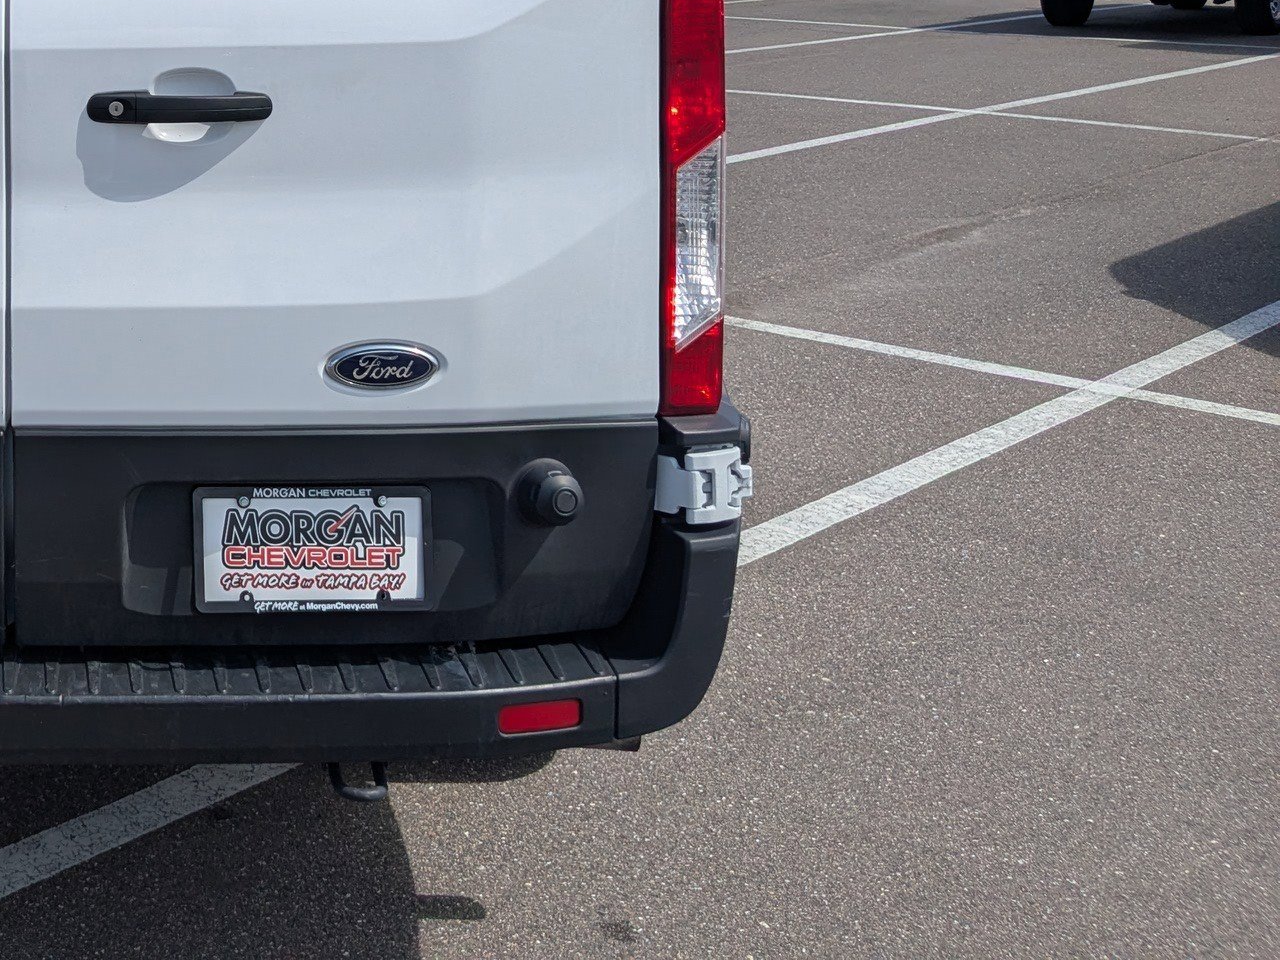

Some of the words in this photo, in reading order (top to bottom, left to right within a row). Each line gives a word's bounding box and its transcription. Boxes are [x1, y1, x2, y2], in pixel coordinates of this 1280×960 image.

[352, 354, 414, 380] Ford
[253, 488, 306, 498] MORGAN
[308, 489, 371, 497] CHEVROLET
[223, 505, 404, 546] MORGAN
[223, 545, 404, 569] CHEVROLET
[221, 573, 253, 590] GET
[253, 573, 300, 589] MORE
[315, 573, 368, 590] TAMPA
[369, 573, 406, 591] BAY!
[254, 601, 273, 613] GET
[273, 601, 299, 611] MORE
[306, 602, 378, 612] MorganChevy.com
